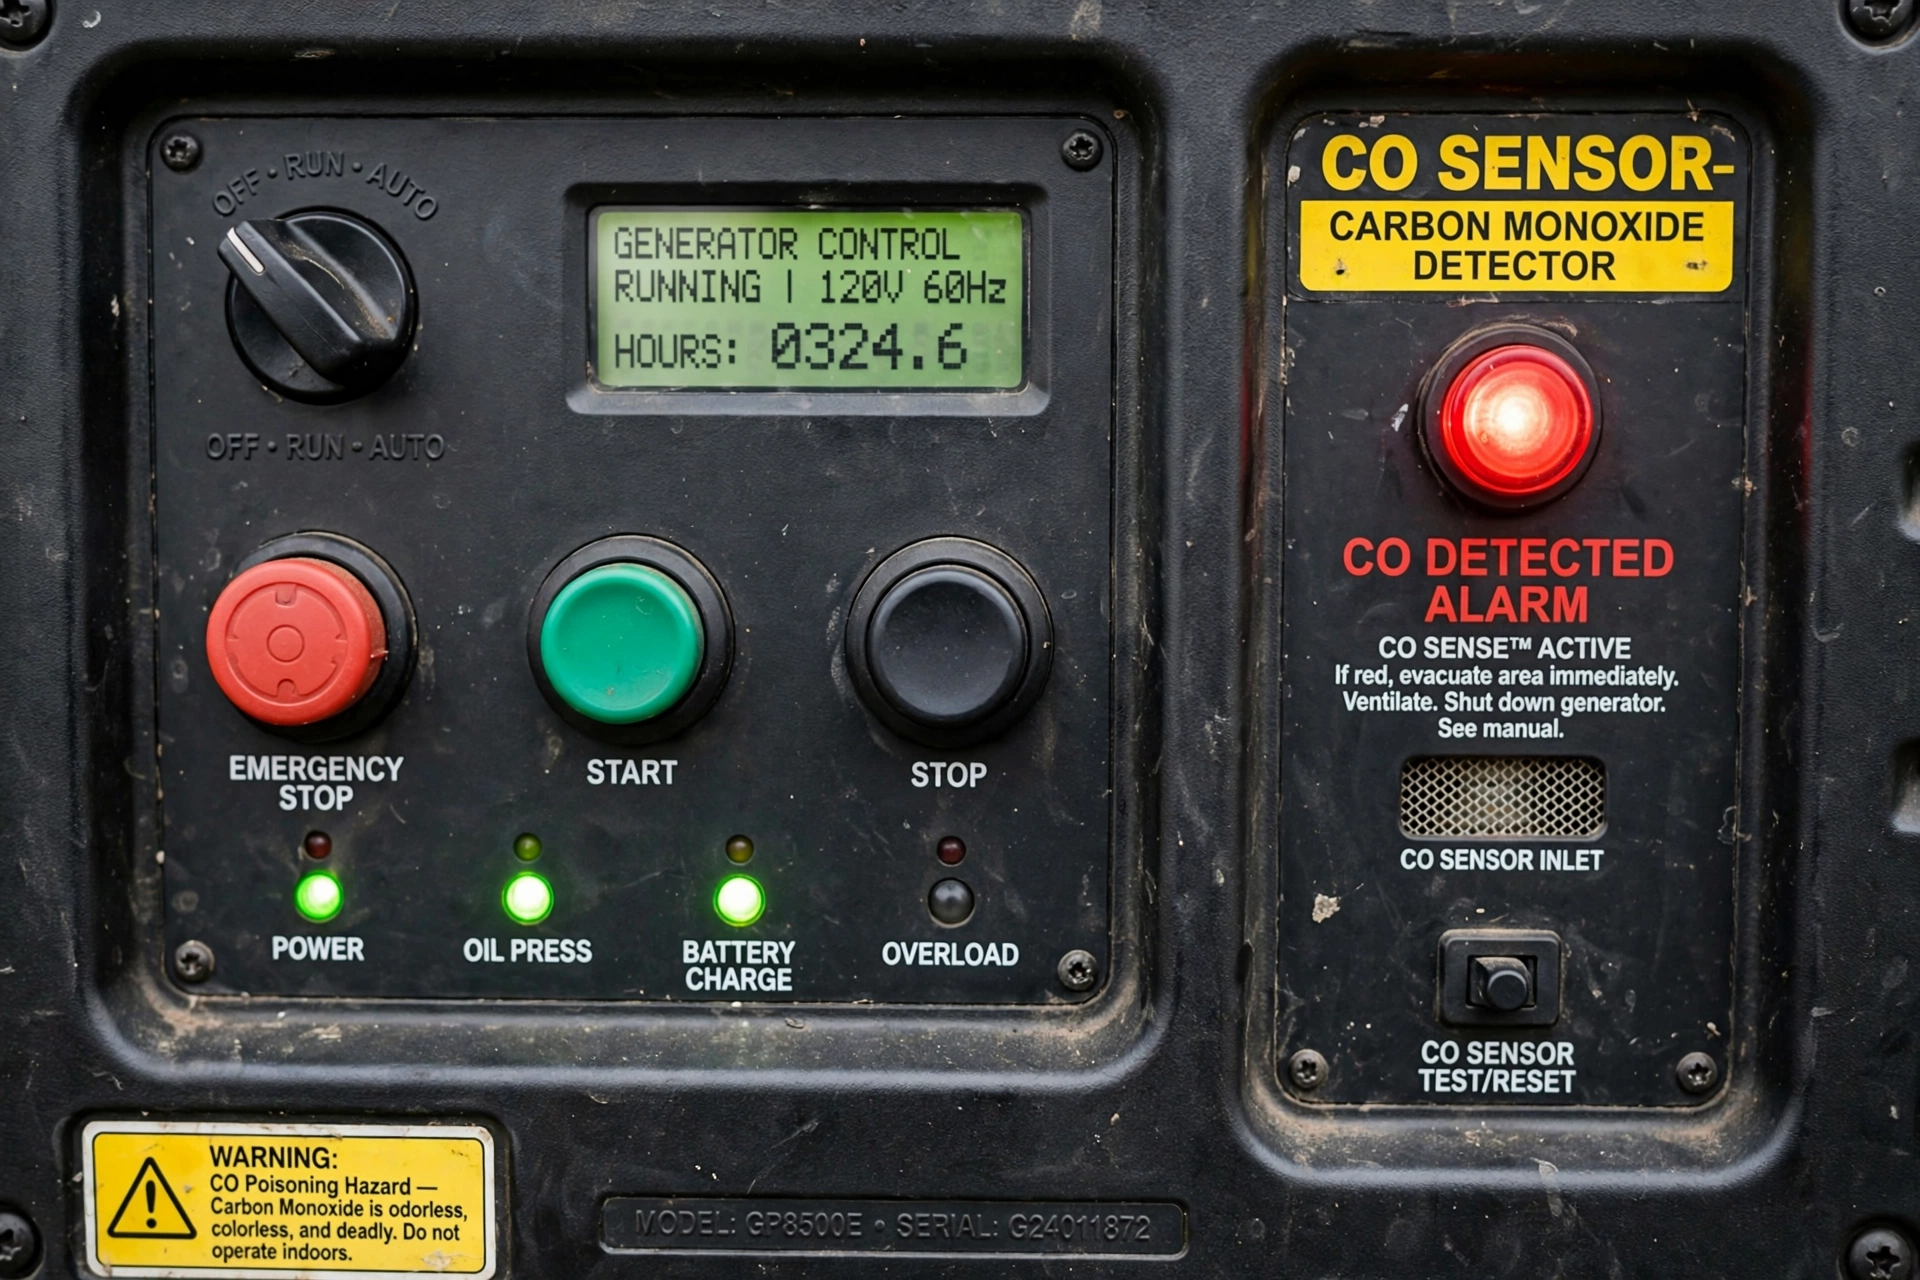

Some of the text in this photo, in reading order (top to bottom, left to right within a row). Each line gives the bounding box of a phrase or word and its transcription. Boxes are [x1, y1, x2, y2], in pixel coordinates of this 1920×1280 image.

[1322, 134, 1734, 191] CO SENSOR-
[213, 167, 262, 217] OFF
[284, 150, 344, 178] RUN
[366, 163, 438, 220] AUTO
[1329, 210, 1704, 241] CARBON MONOXIDE
[614, 227, 960, 260] GENERATOR CONTROL
[1414, 250, 1616, 281] DETECTOR
[614, 269, 761, 303] RUNNING
[821, 269, 903, 304] 120V
[924, 270, 1006, 304] 60Hz
[614, 322, 967, 370] HOURS: 0324.6
[207, 434, 260, 460] OFF
[286, 434, 344, 460] RUN
[368, 434, 445, 461] AUTO
[1343, 537, 1674, 577] CO DETECTED
[1425, 585, 1588, 623] ALARM
[1378, 636, 1417, 659] CO
[1538, 637, 1631, 660] ACTIVE
[1335, 664, 1679, 691] If red, evacuate area immediately.
[1343, 691, 1666, 717] Ventilate. Shut down generator.
[1438, 718, 1564, 738] See manual.
[229, 755, 404, 782] EMERGENCY
[586, 759, 678, 786] START
[911, 761, 987, 788] STOP
[279, 785, 354, 811] STOP
[1400, 849, 1604, 871] CO SENSOR INLET
[272, 936, 365, 961] POWER
[463, 938, 592, 963] OIL PRESS
[682, 940, 795, 965] BATTERY
[882, 941, 1019, 967] OVERLOAD
[685, 967, 793, 992] CHARGE
[1421, 1040, 1574, 1065] CO SENSOR
[1418, 1068, 1576, 1093] TEST/RESET
[209, 1145, 338, 1169] WARNING:
[210, 1174, 239, 1193] CO
[245, 1175, 339, 1199] Poisoning
[345, 1177, 411, 1196] Hazard
[211, 1197, 468, 1222] Carbon Monoxide is odorless,
[211, 1220, 460, 1245] colorless, and deadly. Do not
[635, 1209, 735, 1236] MODEL:
[745, 1211, 863, 1237] GP8500E
[896, 1213, 998, 1239] SERIAL:
[1007, 1213, 1151, 1240] G24011872
[212, 1243, 353, 1264] operate indoors.
